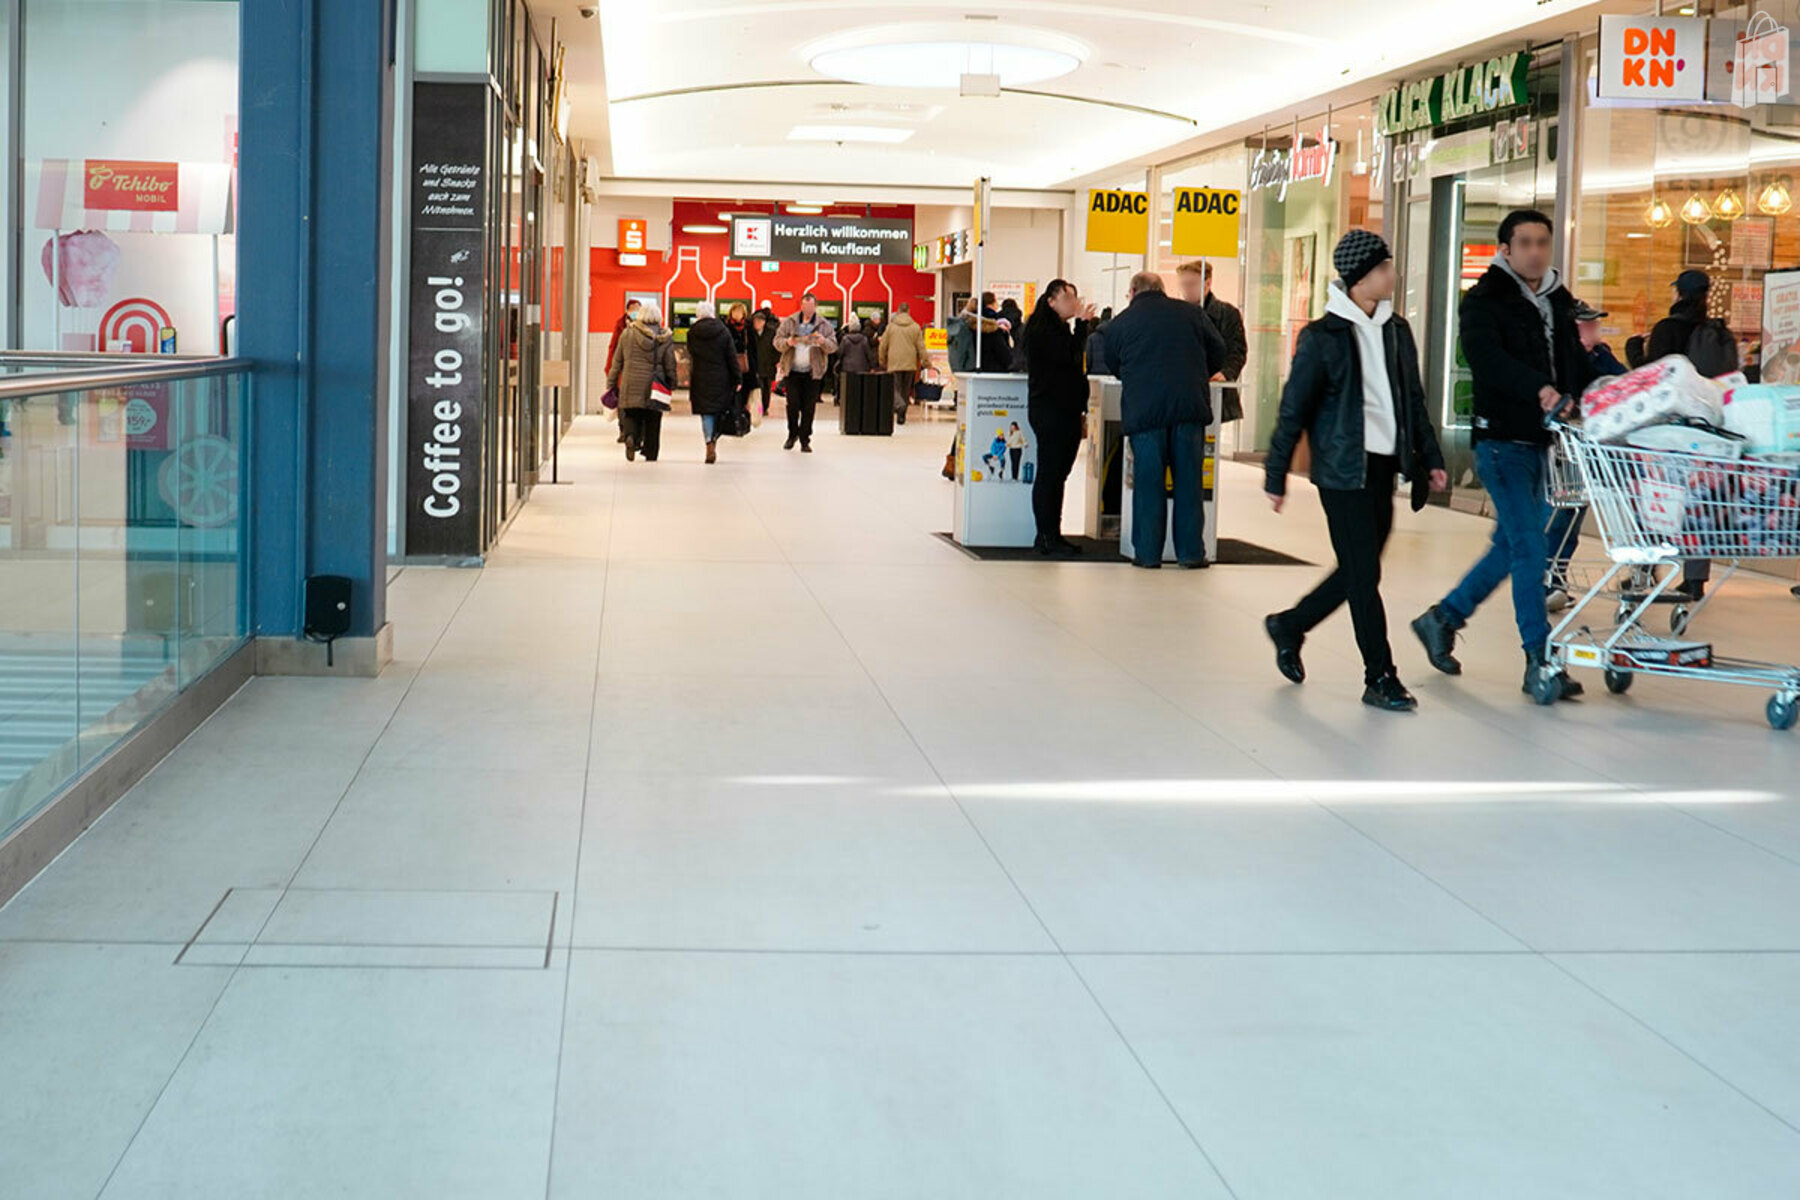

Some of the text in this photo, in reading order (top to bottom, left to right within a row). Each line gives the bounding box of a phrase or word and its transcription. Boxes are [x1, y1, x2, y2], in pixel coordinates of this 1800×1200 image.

[1624, 27, 1676, 57] DN
[1378, 52, 1519, 136] KLICK KLACK
[112, 175, 174, 192] Tchibo
[136, 193, 168, 203] MOBIL
[1092, 192, 1148, 215] ADAC
[1177, 191, 1238, 215] ADAC
[774, 223, 908, 240] Herzlich willkommen
[820, 241, 882, 256] Kaufland
[423, 276, 472, 518] Coffee to go!
